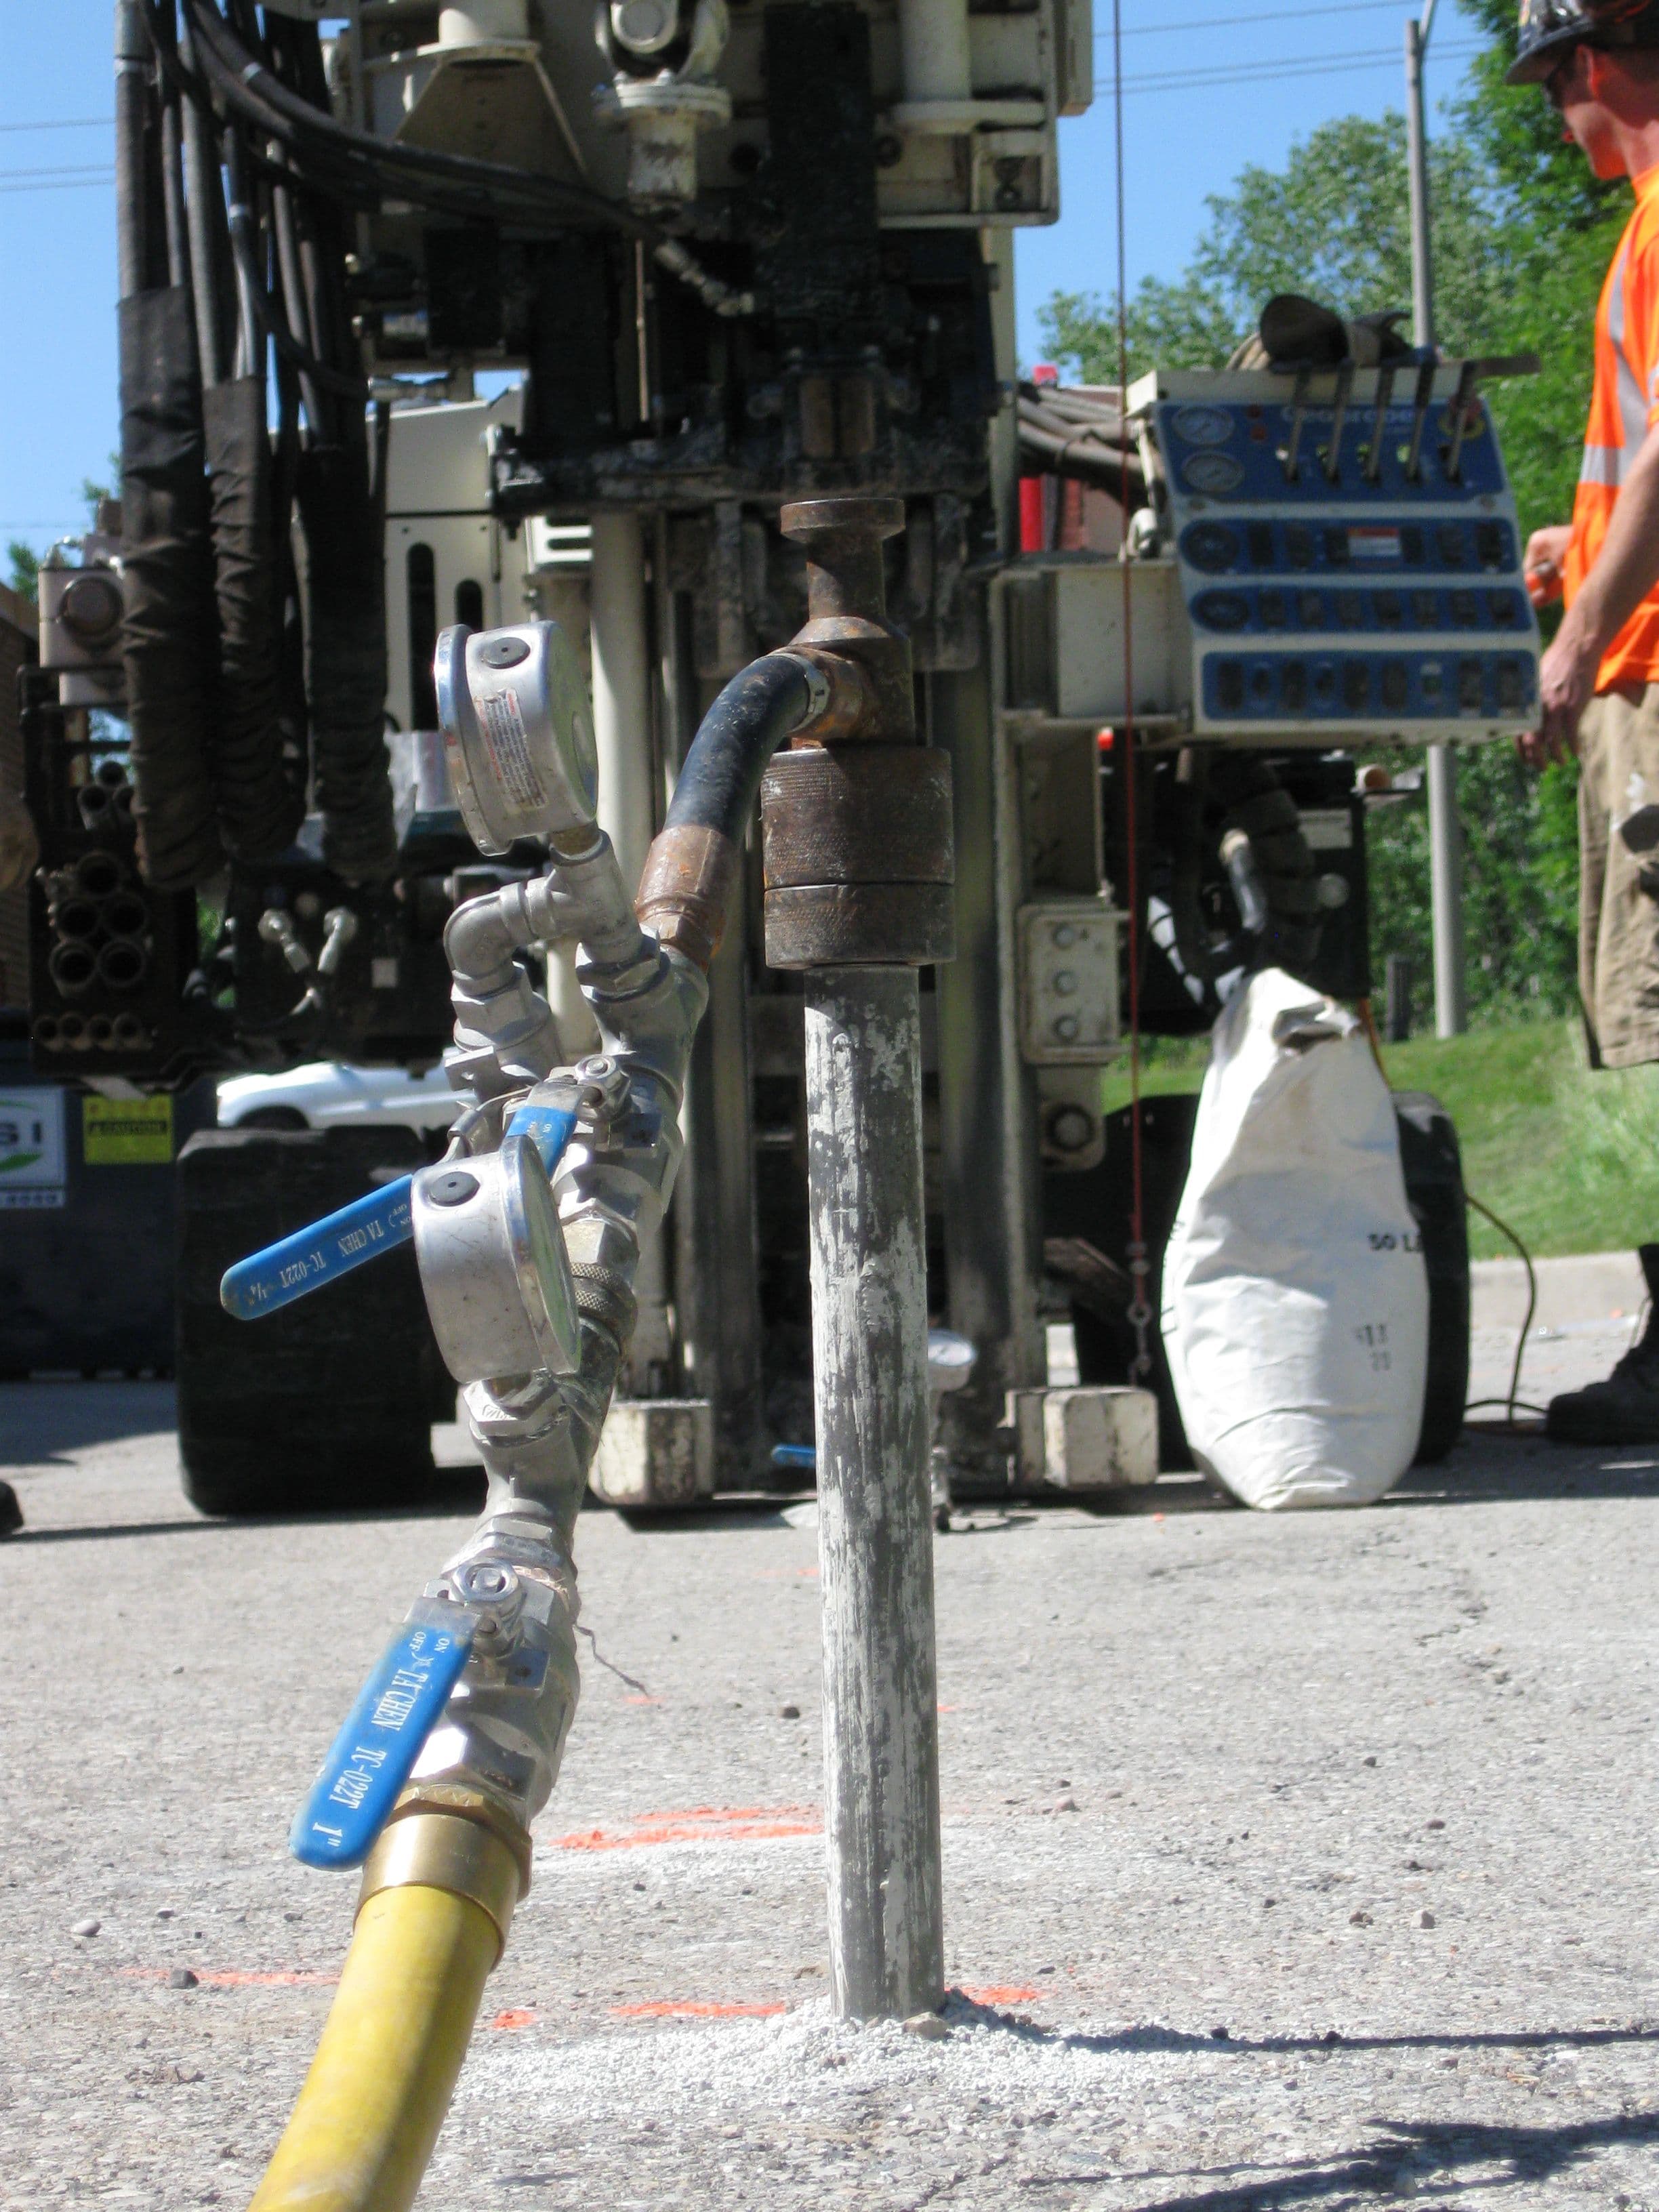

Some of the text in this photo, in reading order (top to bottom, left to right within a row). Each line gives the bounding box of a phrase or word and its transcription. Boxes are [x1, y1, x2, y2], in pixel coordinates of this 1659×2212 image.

[338, 1229, 367, 1257] CHEN
[367, 1220, 384, 1241] TA
[280, 1252, 326, 1288] TC-022T
[409, 1631, 426, 1652] OFF
[434, 1637, 450, 1653] ON
[392, 1668, 429, 1690] TA
[371, 1689, 417, 1732] CHEN
[329, 1746, 387, 1809] TC-022T
